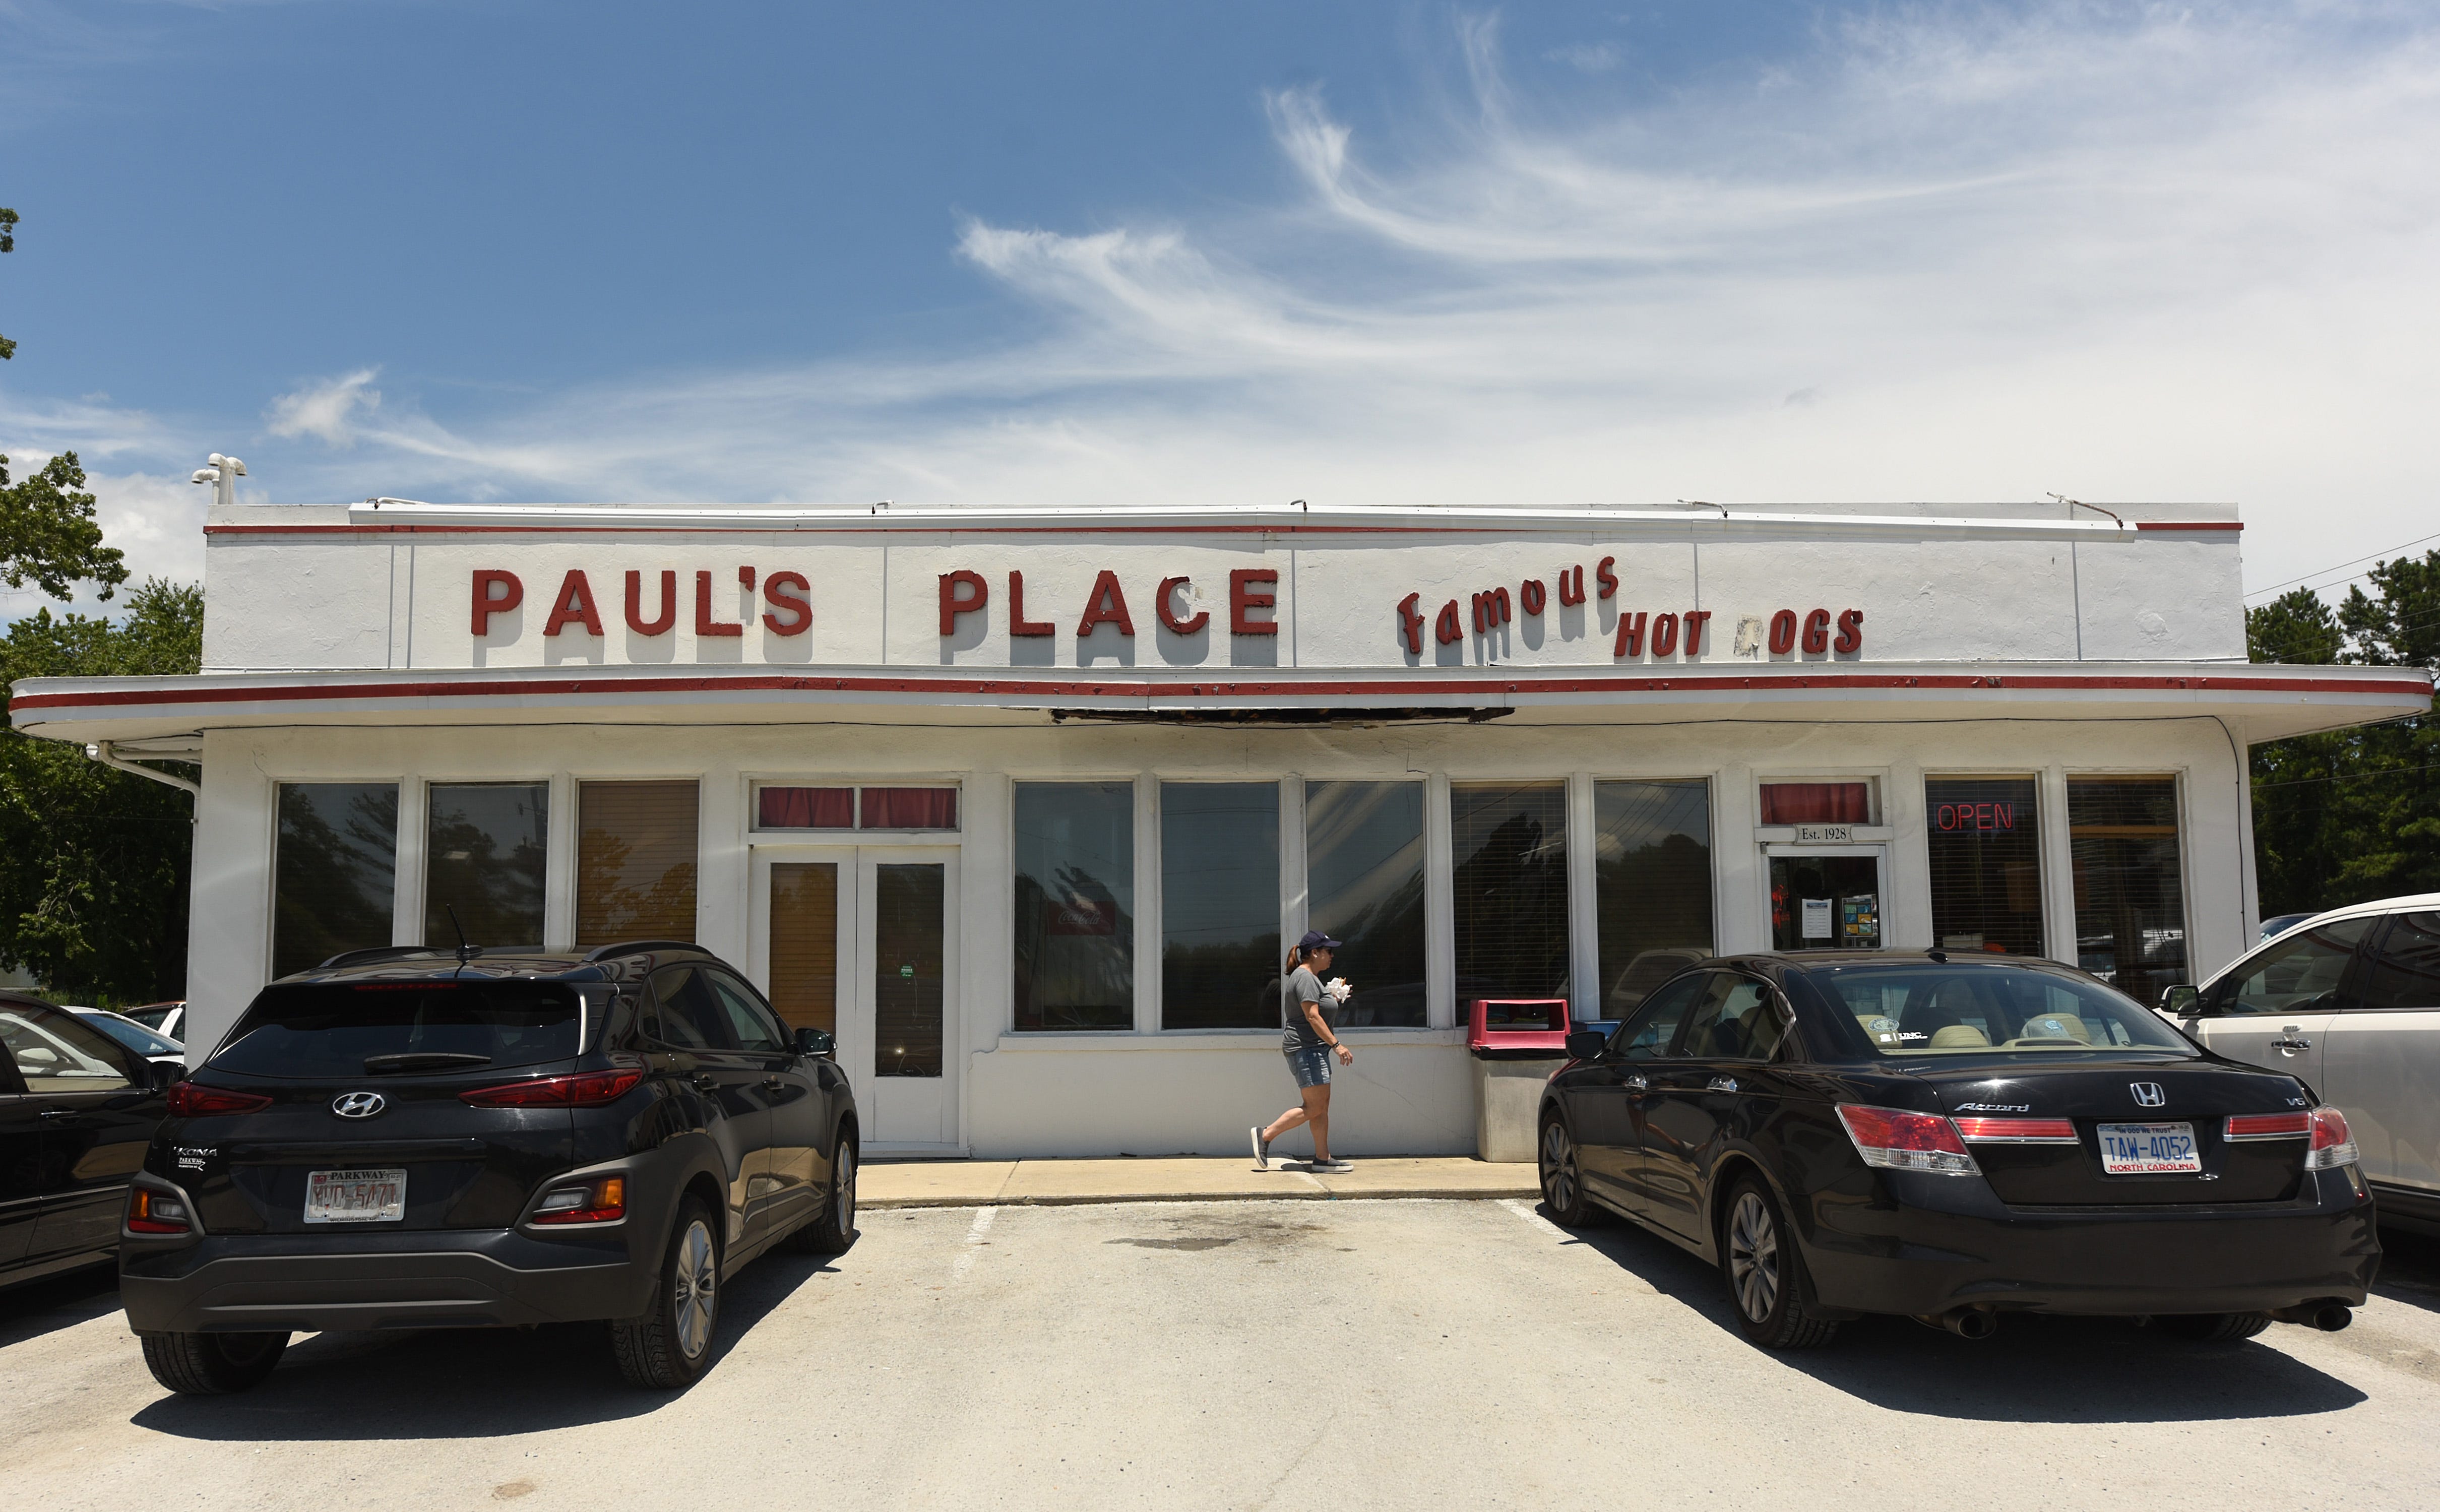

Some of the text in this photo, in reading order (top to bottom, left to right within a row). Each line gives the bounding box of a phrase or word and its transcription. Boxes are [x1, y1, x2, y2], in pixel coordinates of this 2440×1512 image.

[471, 565, 1278, 637] PAUL'S PLACE
[1614, 610, 1712, 657] HOT
[1937, 803, 2012, 830] OPEN
[1802, 828, 1846, 840] Est. 1928
[1954, 1103, 2029, 1112] Accord
[2284, 1098, 2305, 1106] V6
[2105, 1136, 2194, 1161] TAW-4052
[2110, 1163, 2196, 1172] NORTH CAROLINA
[331, 1170, 386, 1180] PARKWAY
